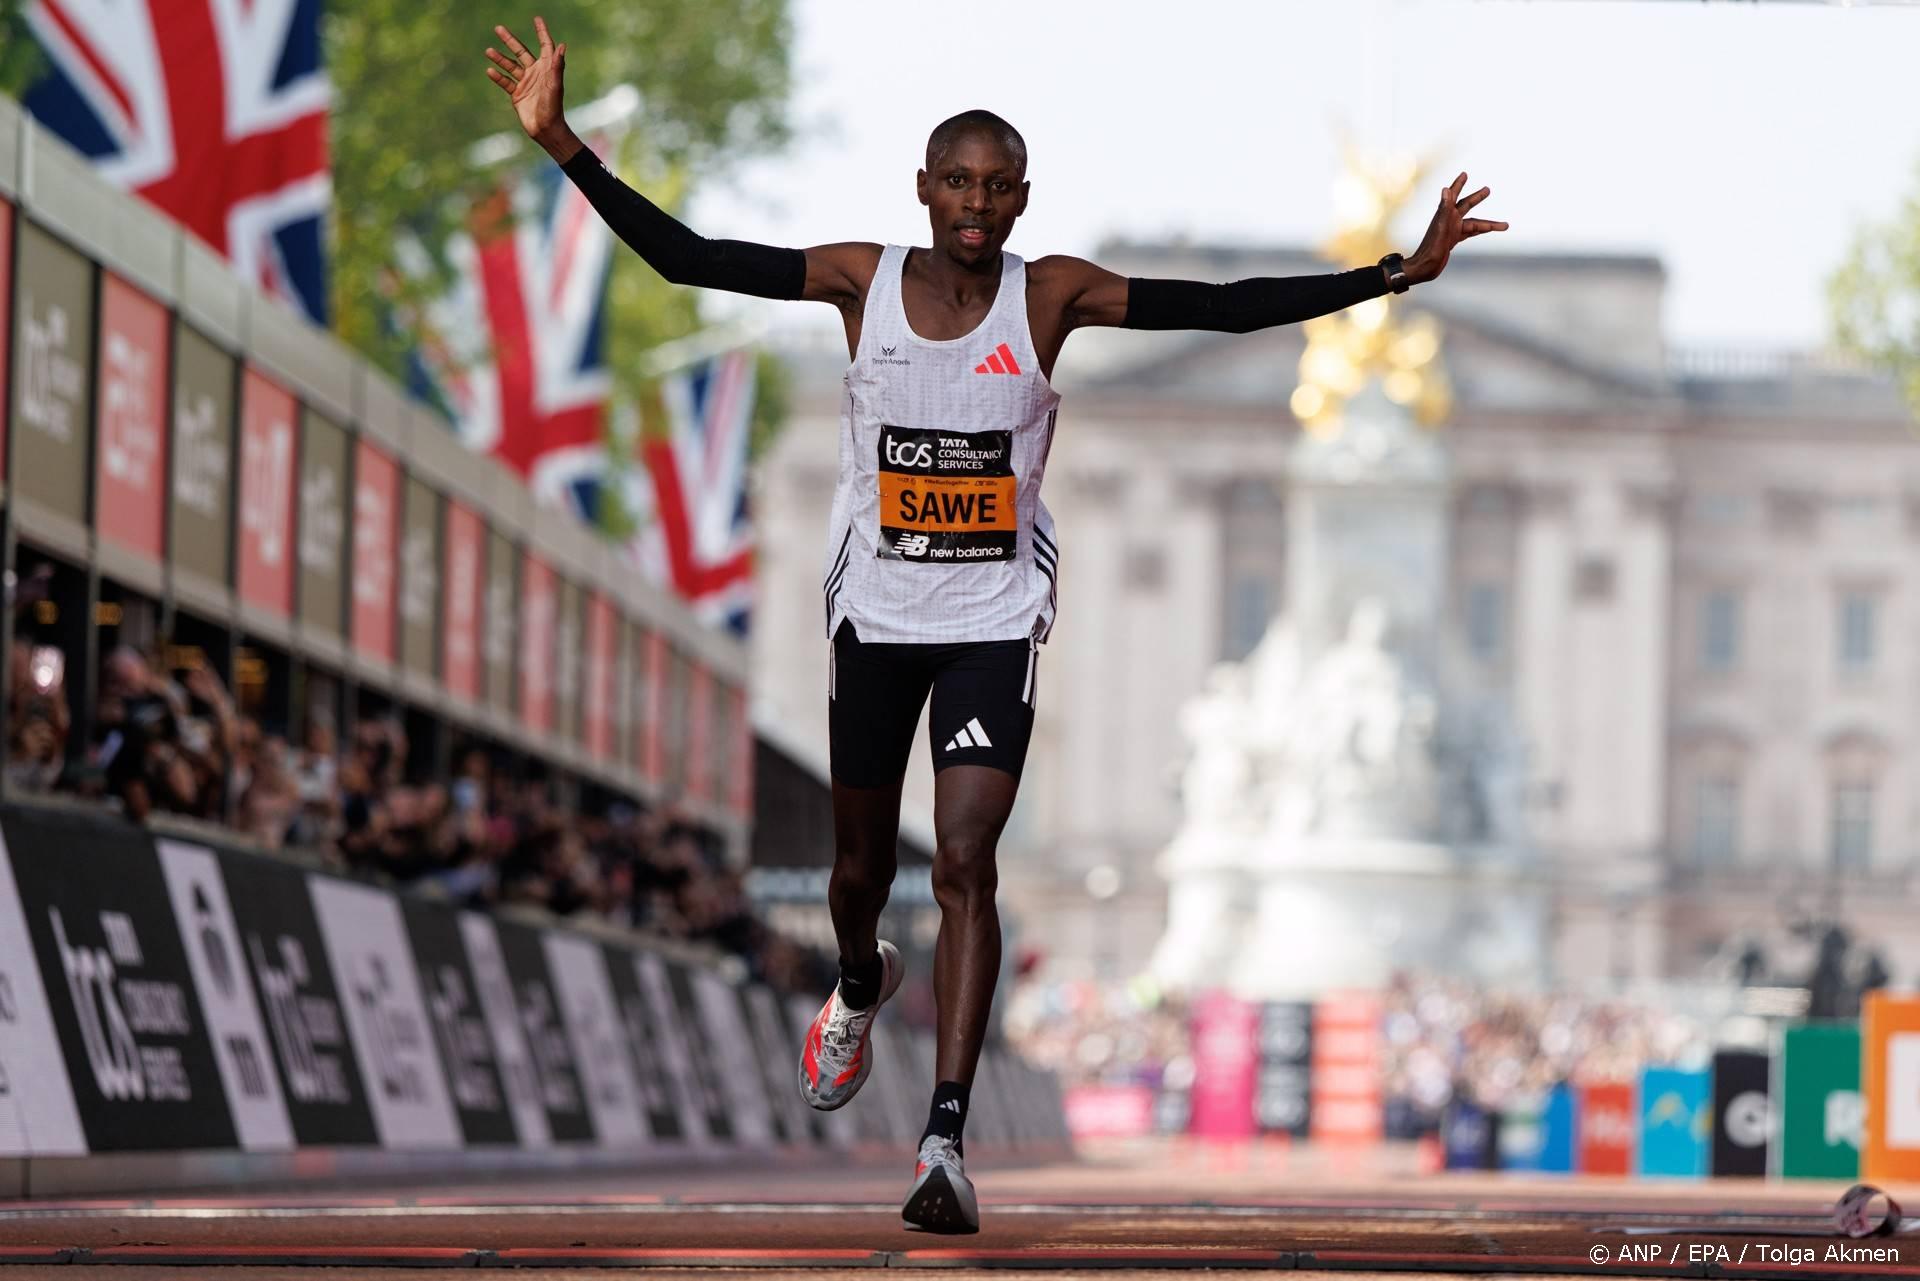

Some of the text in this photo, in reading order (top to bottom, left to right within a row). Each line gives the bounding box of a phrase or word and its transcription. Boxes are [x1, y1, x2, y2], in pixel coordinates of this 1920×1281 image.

[938, 438, 969, 448] TATA
[885, 434, 933, 468] tcs
[938, 449, 1002, 460] CONSULTANCY
[938, 460, 984, 470] SERVICES
[899, 489, 997, 524] SAWE
[930, 546, 1003, 558] new balance
